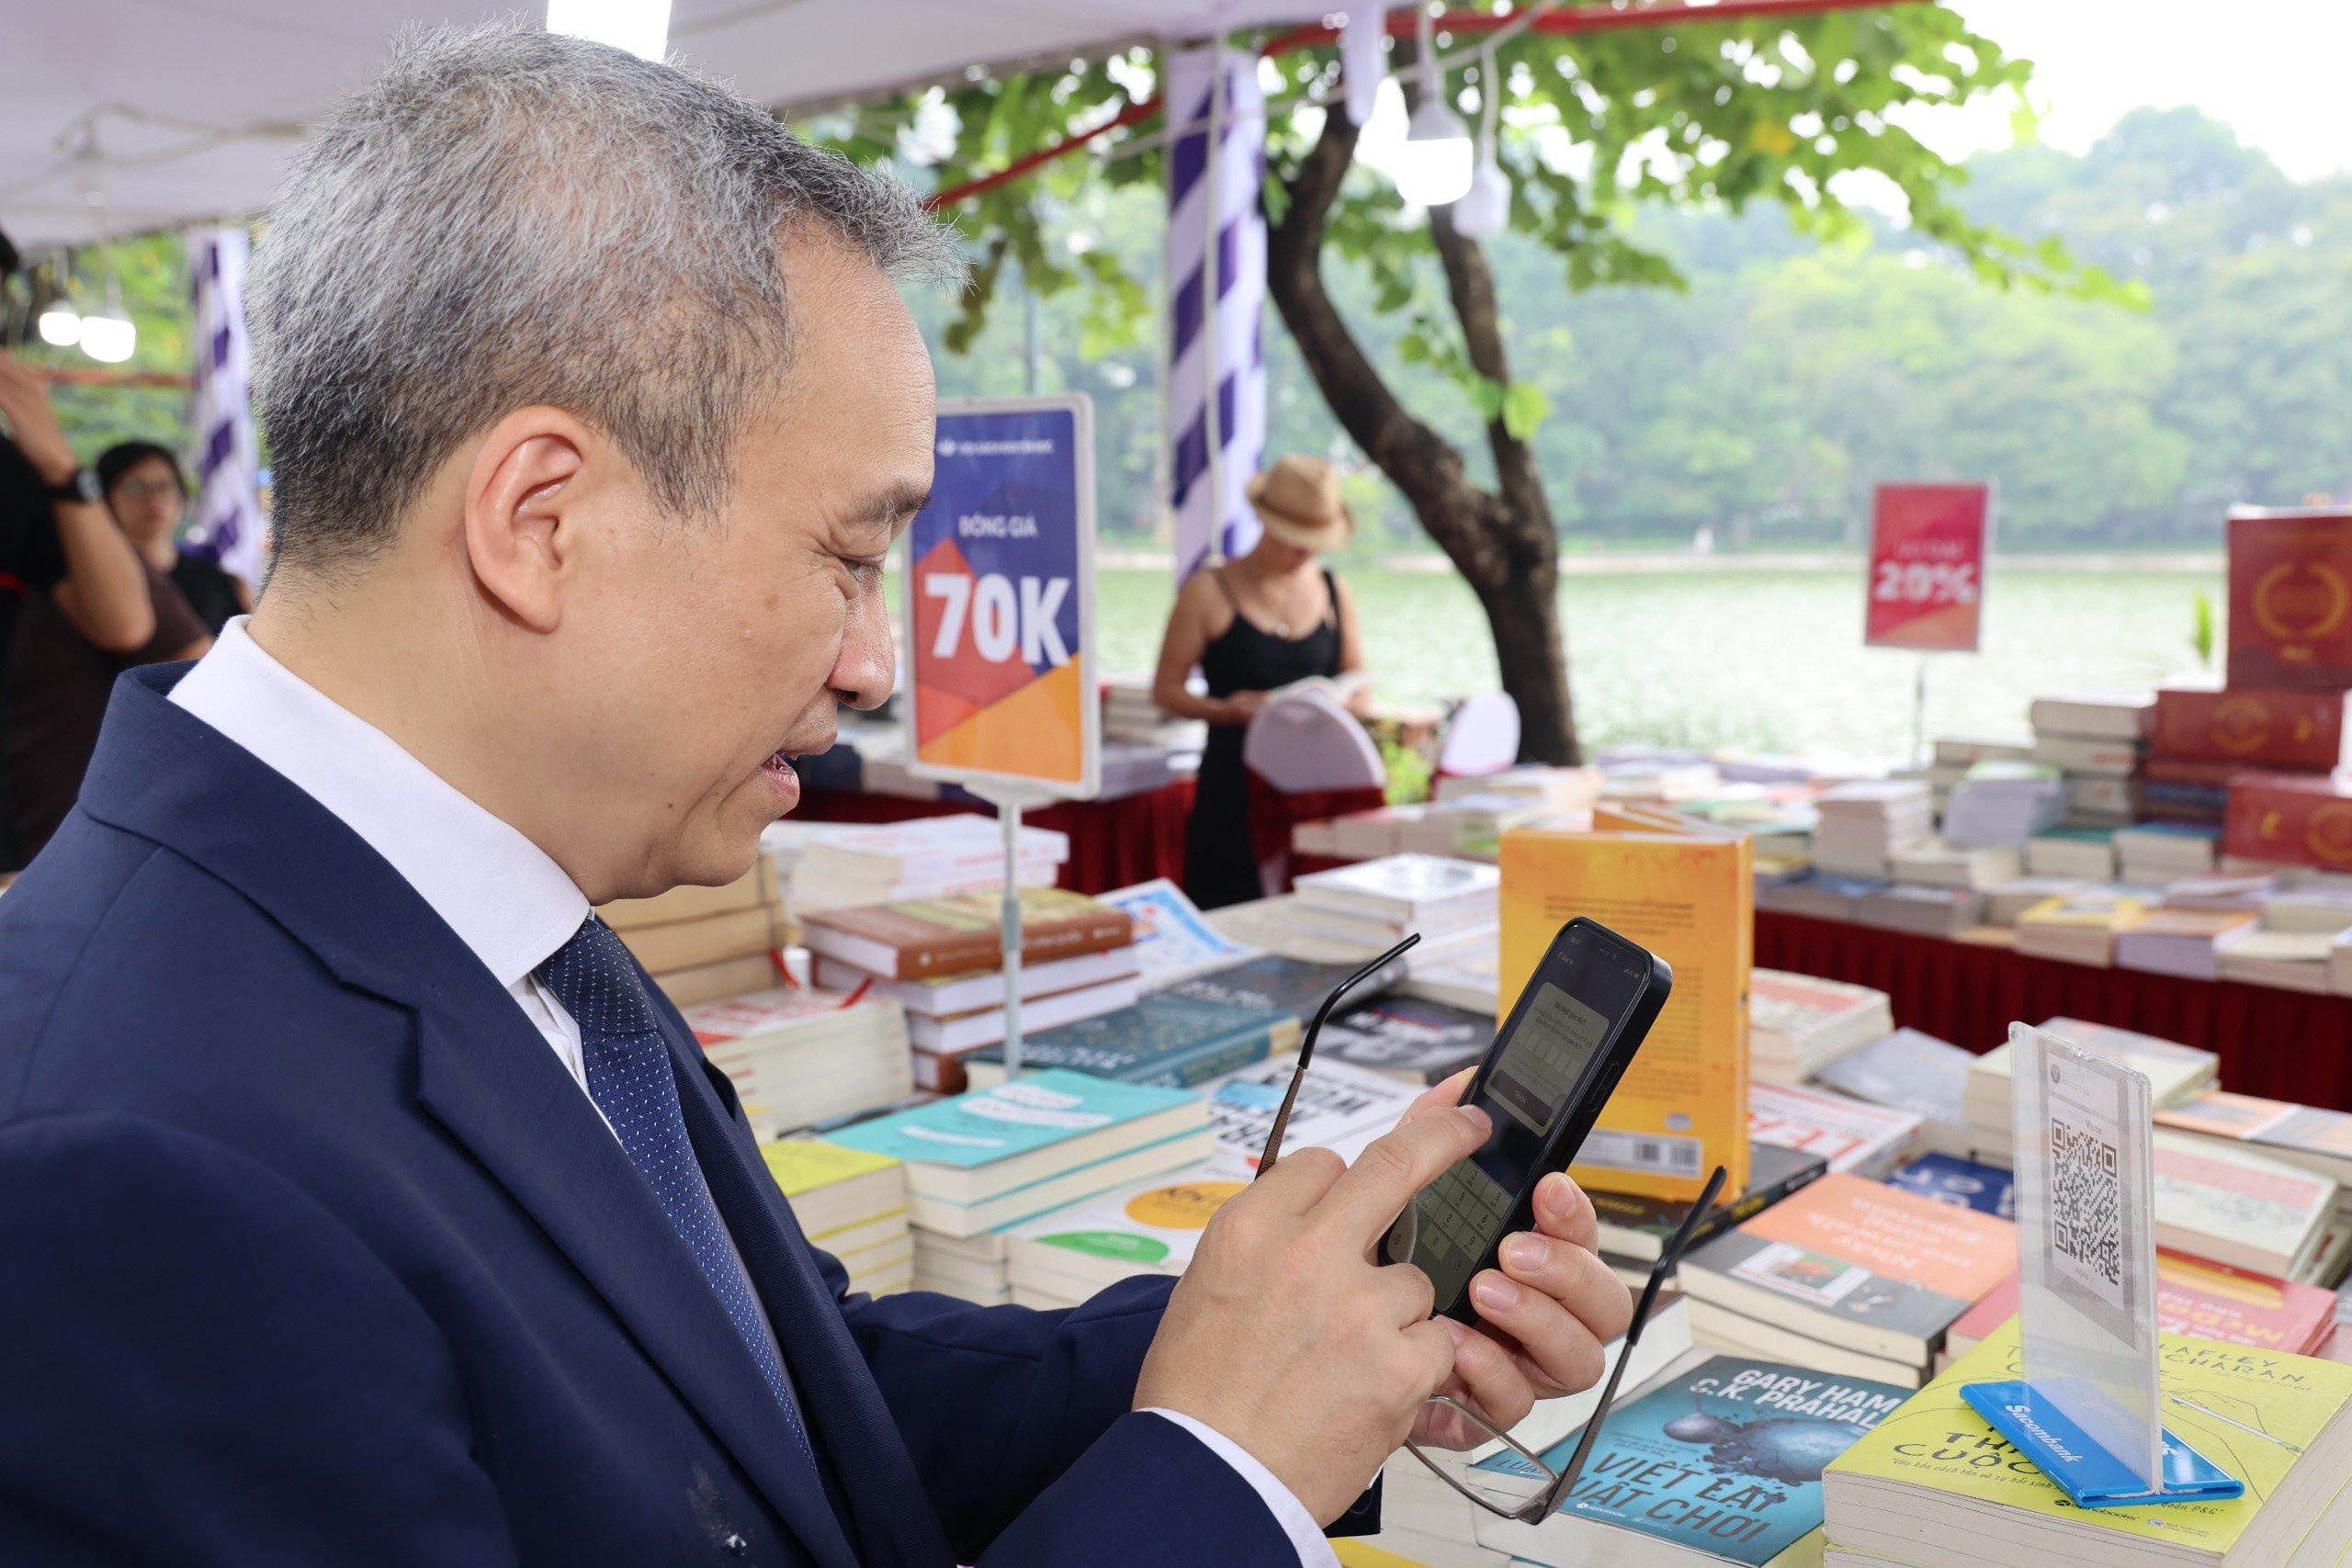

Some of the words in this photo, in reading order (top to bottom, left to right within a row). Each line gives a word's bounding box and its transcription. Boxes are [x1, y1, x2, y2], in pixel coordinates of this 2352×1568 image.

[1873, 560, 1977, 604] 20%
[924, 573, 1071, 667] 70K
[2159, 1344, 2278, 1368] LAFLEY
[2165, 1354, 2304, 1382] CHARAN
[1732, 1369, 1824, 1396] GARY
[1819, 1385, 1903, 1414] HAM
[1754, 1390, 1881, 1428] PRAHAL
[2005, 1404, 2085, 1463] Sacombank
[1592, 1452, 1703, 1490] VIẾT
[1893, 1443, 2041, 1475] CUỘC
[1914, 1461, 1930, 1470] hóa
[1933, 1464, 1958, 1473] cách
[1980, 1472, 1991, 1480] và
[2030, 1480, 2052, 1489] sinh
[1570, 1475, 1653, 1508] UẬT
[1645, 1498, 1771, 1543] CHƠI
